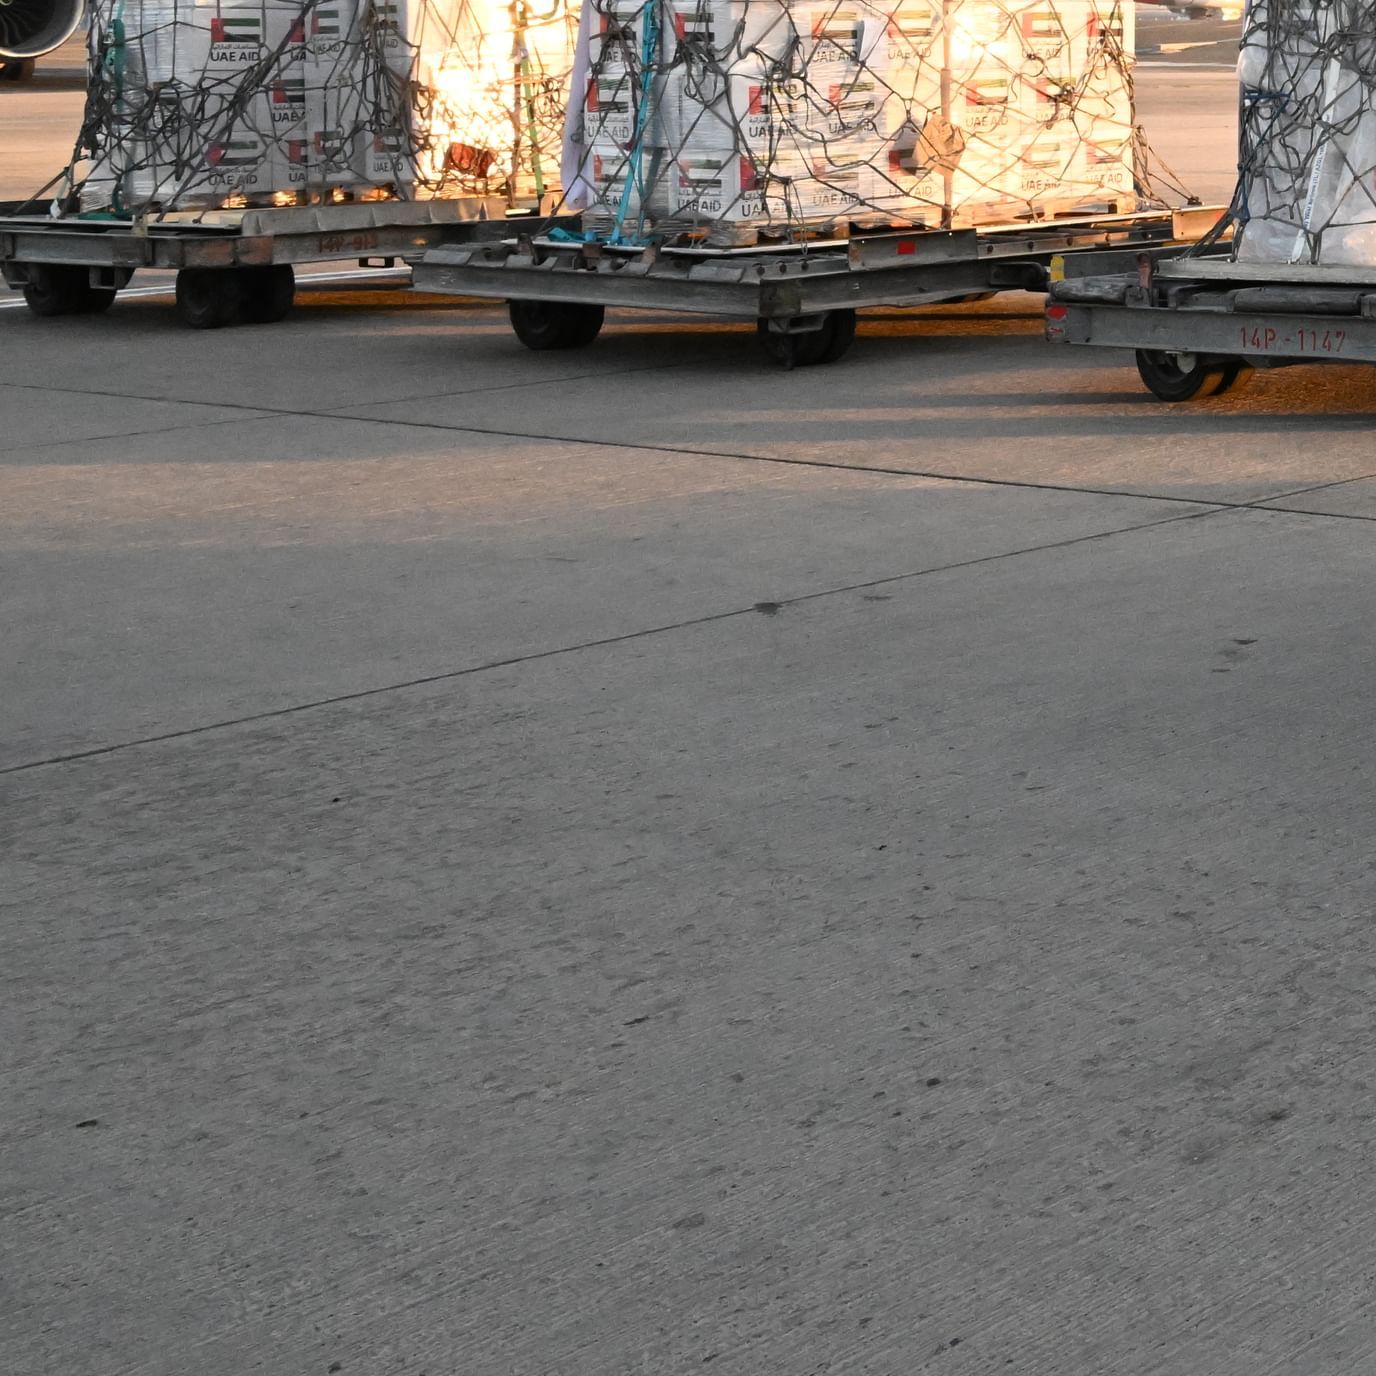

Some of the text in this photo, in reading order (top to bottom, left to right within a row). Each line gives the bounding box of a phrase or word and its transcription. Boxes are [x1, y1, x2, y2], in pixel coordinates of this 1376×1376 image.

[211, 51, 261, 62] UAE AID
[966, 117, 989, 127] UAE
[588, 126, 630, 138] UAE AID
[373, 162, 390, 172] UAE
[209, 175, 258, 185] UAE AID
[677, 198, 722, 212] UAE AID
[813, 194, 838, 206] UAE
